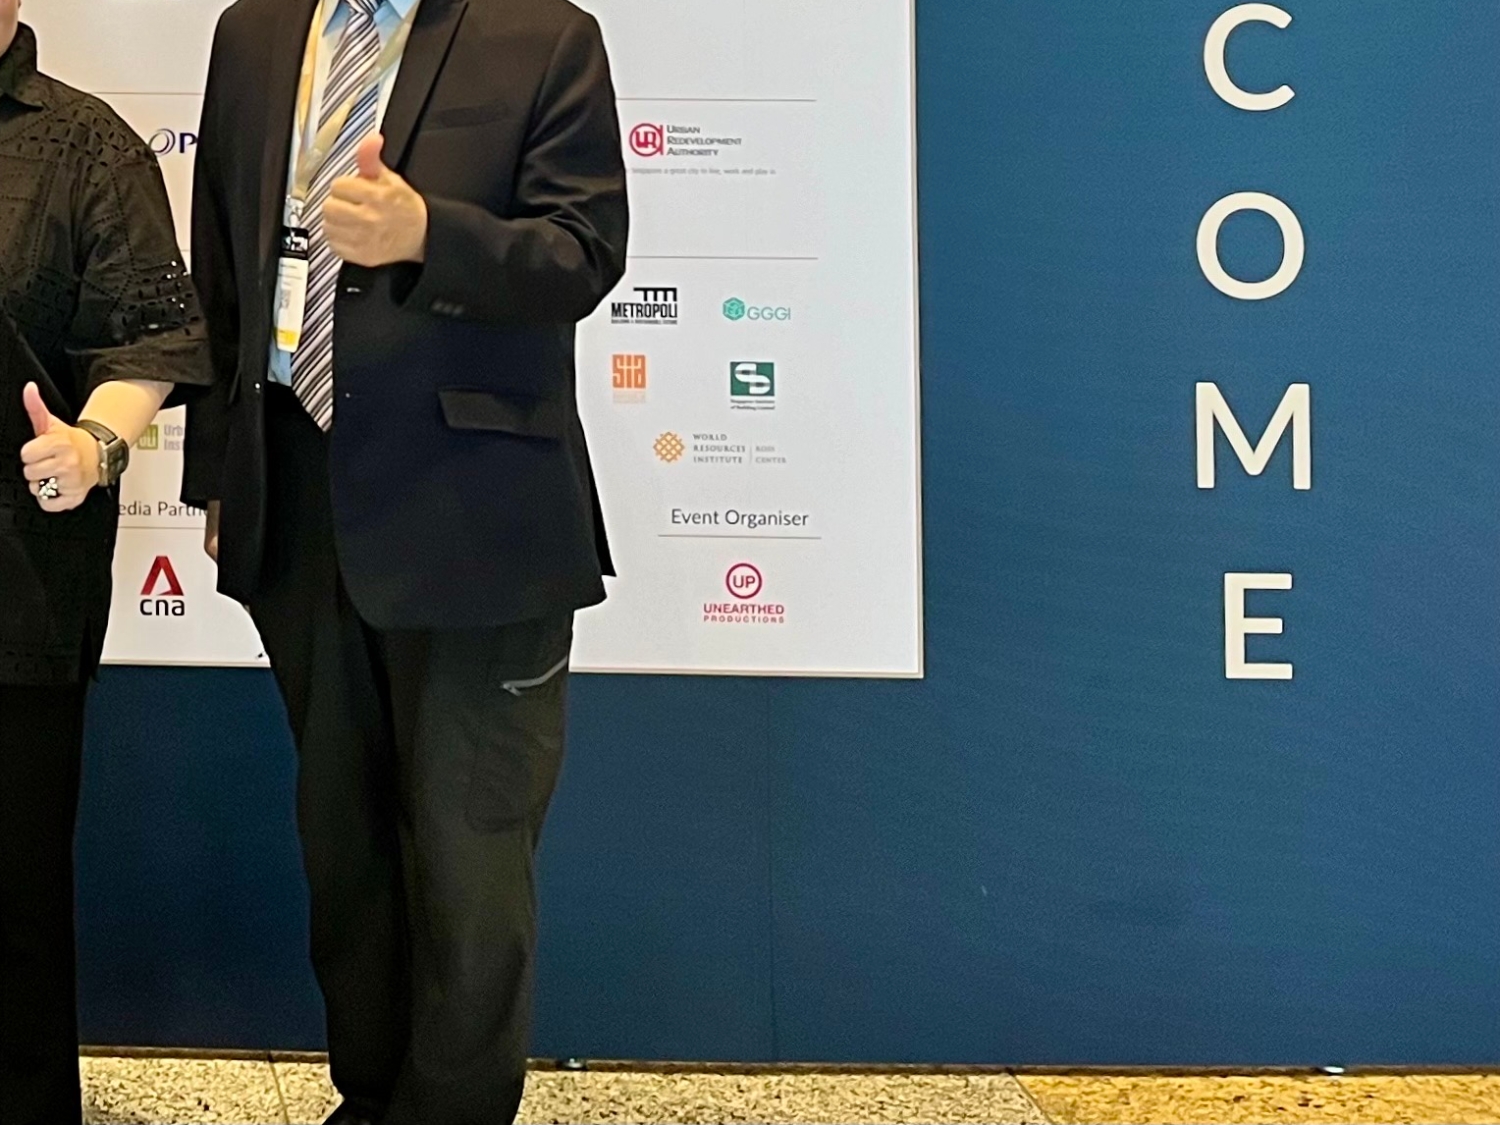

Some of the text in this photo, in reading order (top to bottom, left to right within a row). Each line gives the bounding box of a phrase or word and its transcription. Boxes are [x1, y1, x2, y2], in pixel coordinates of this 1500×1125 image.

[746, 306, 791, 321] GGGI
[692, 433, 728, 441] WORLD
[693, 444, 746, 453] RESOURCES
[693, 456, 743, 464] INSTITUTE
[119, 500, 152, 516] edia
[671, 507, 809, 528] Event Organiser
[732, 575, 756, 589] UP
[139, 598, 185, 617] cna
[703, 603, 785, 615] UNEARTHED
[703, 615, 785, 624] PRODUCTIONS
